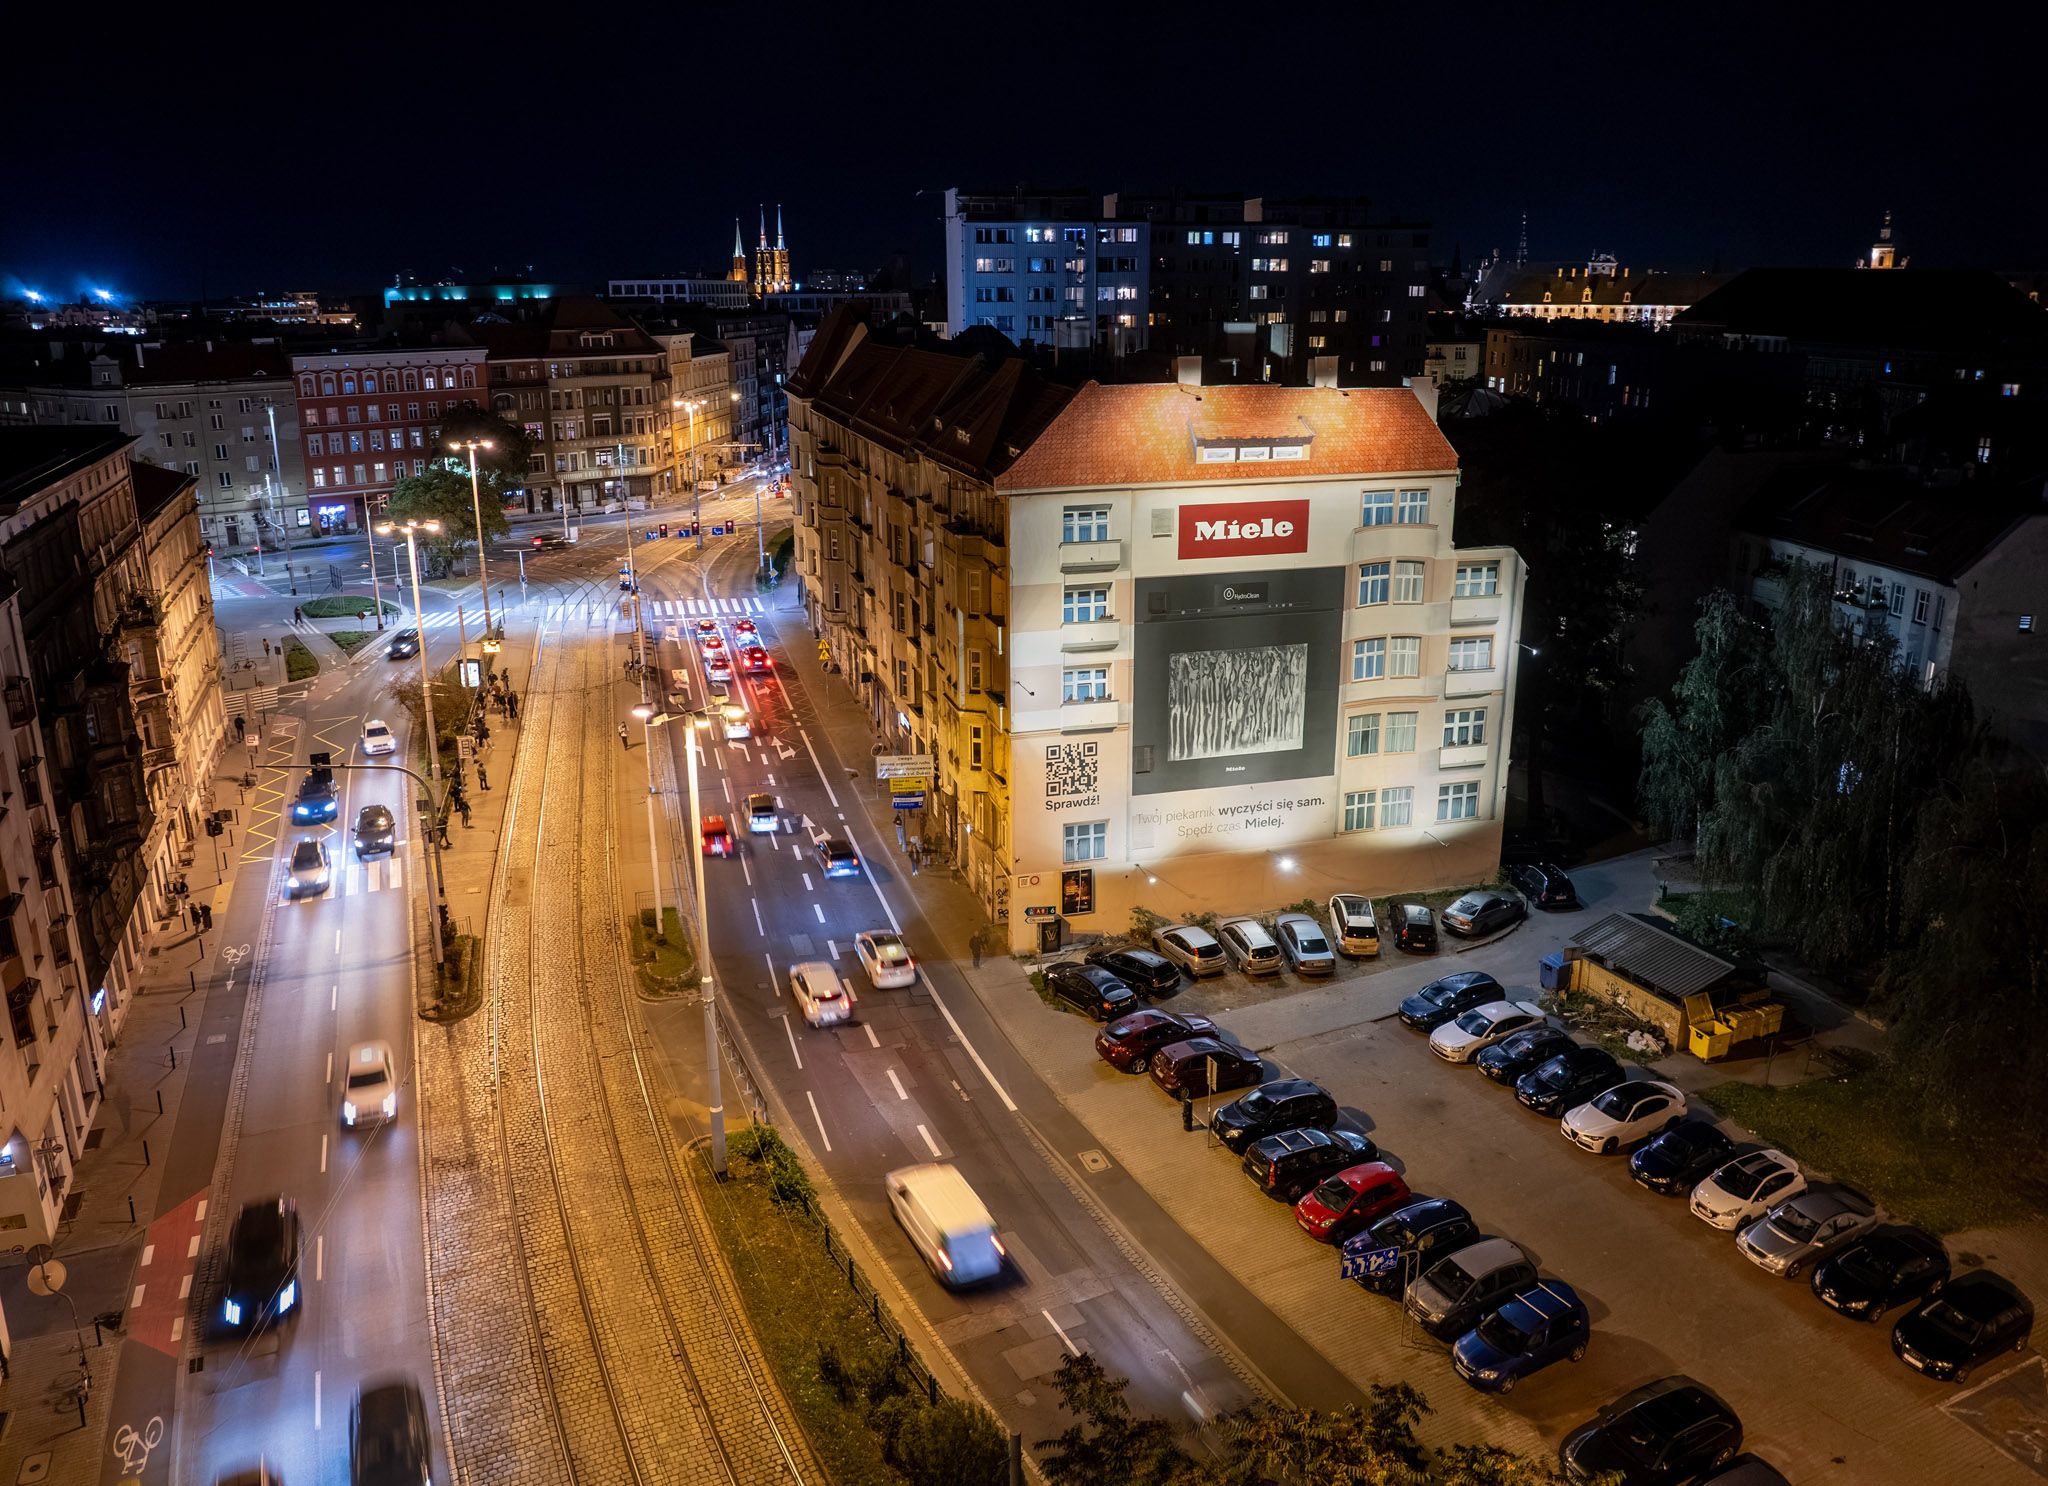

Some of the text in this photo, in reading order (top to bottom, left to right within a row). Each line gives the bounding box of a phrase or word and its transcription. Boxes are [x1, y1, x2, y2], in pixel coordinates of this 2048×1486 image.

[1194, 518, 1294, 541] Miele
[1045, 795, 1100, 812] Sprawdź!
[1136, 797, 1325, 825] Twój piekarnik wyczyści się sam.
[1177, 815, 1285, 838] Spędź czas Mielej.
